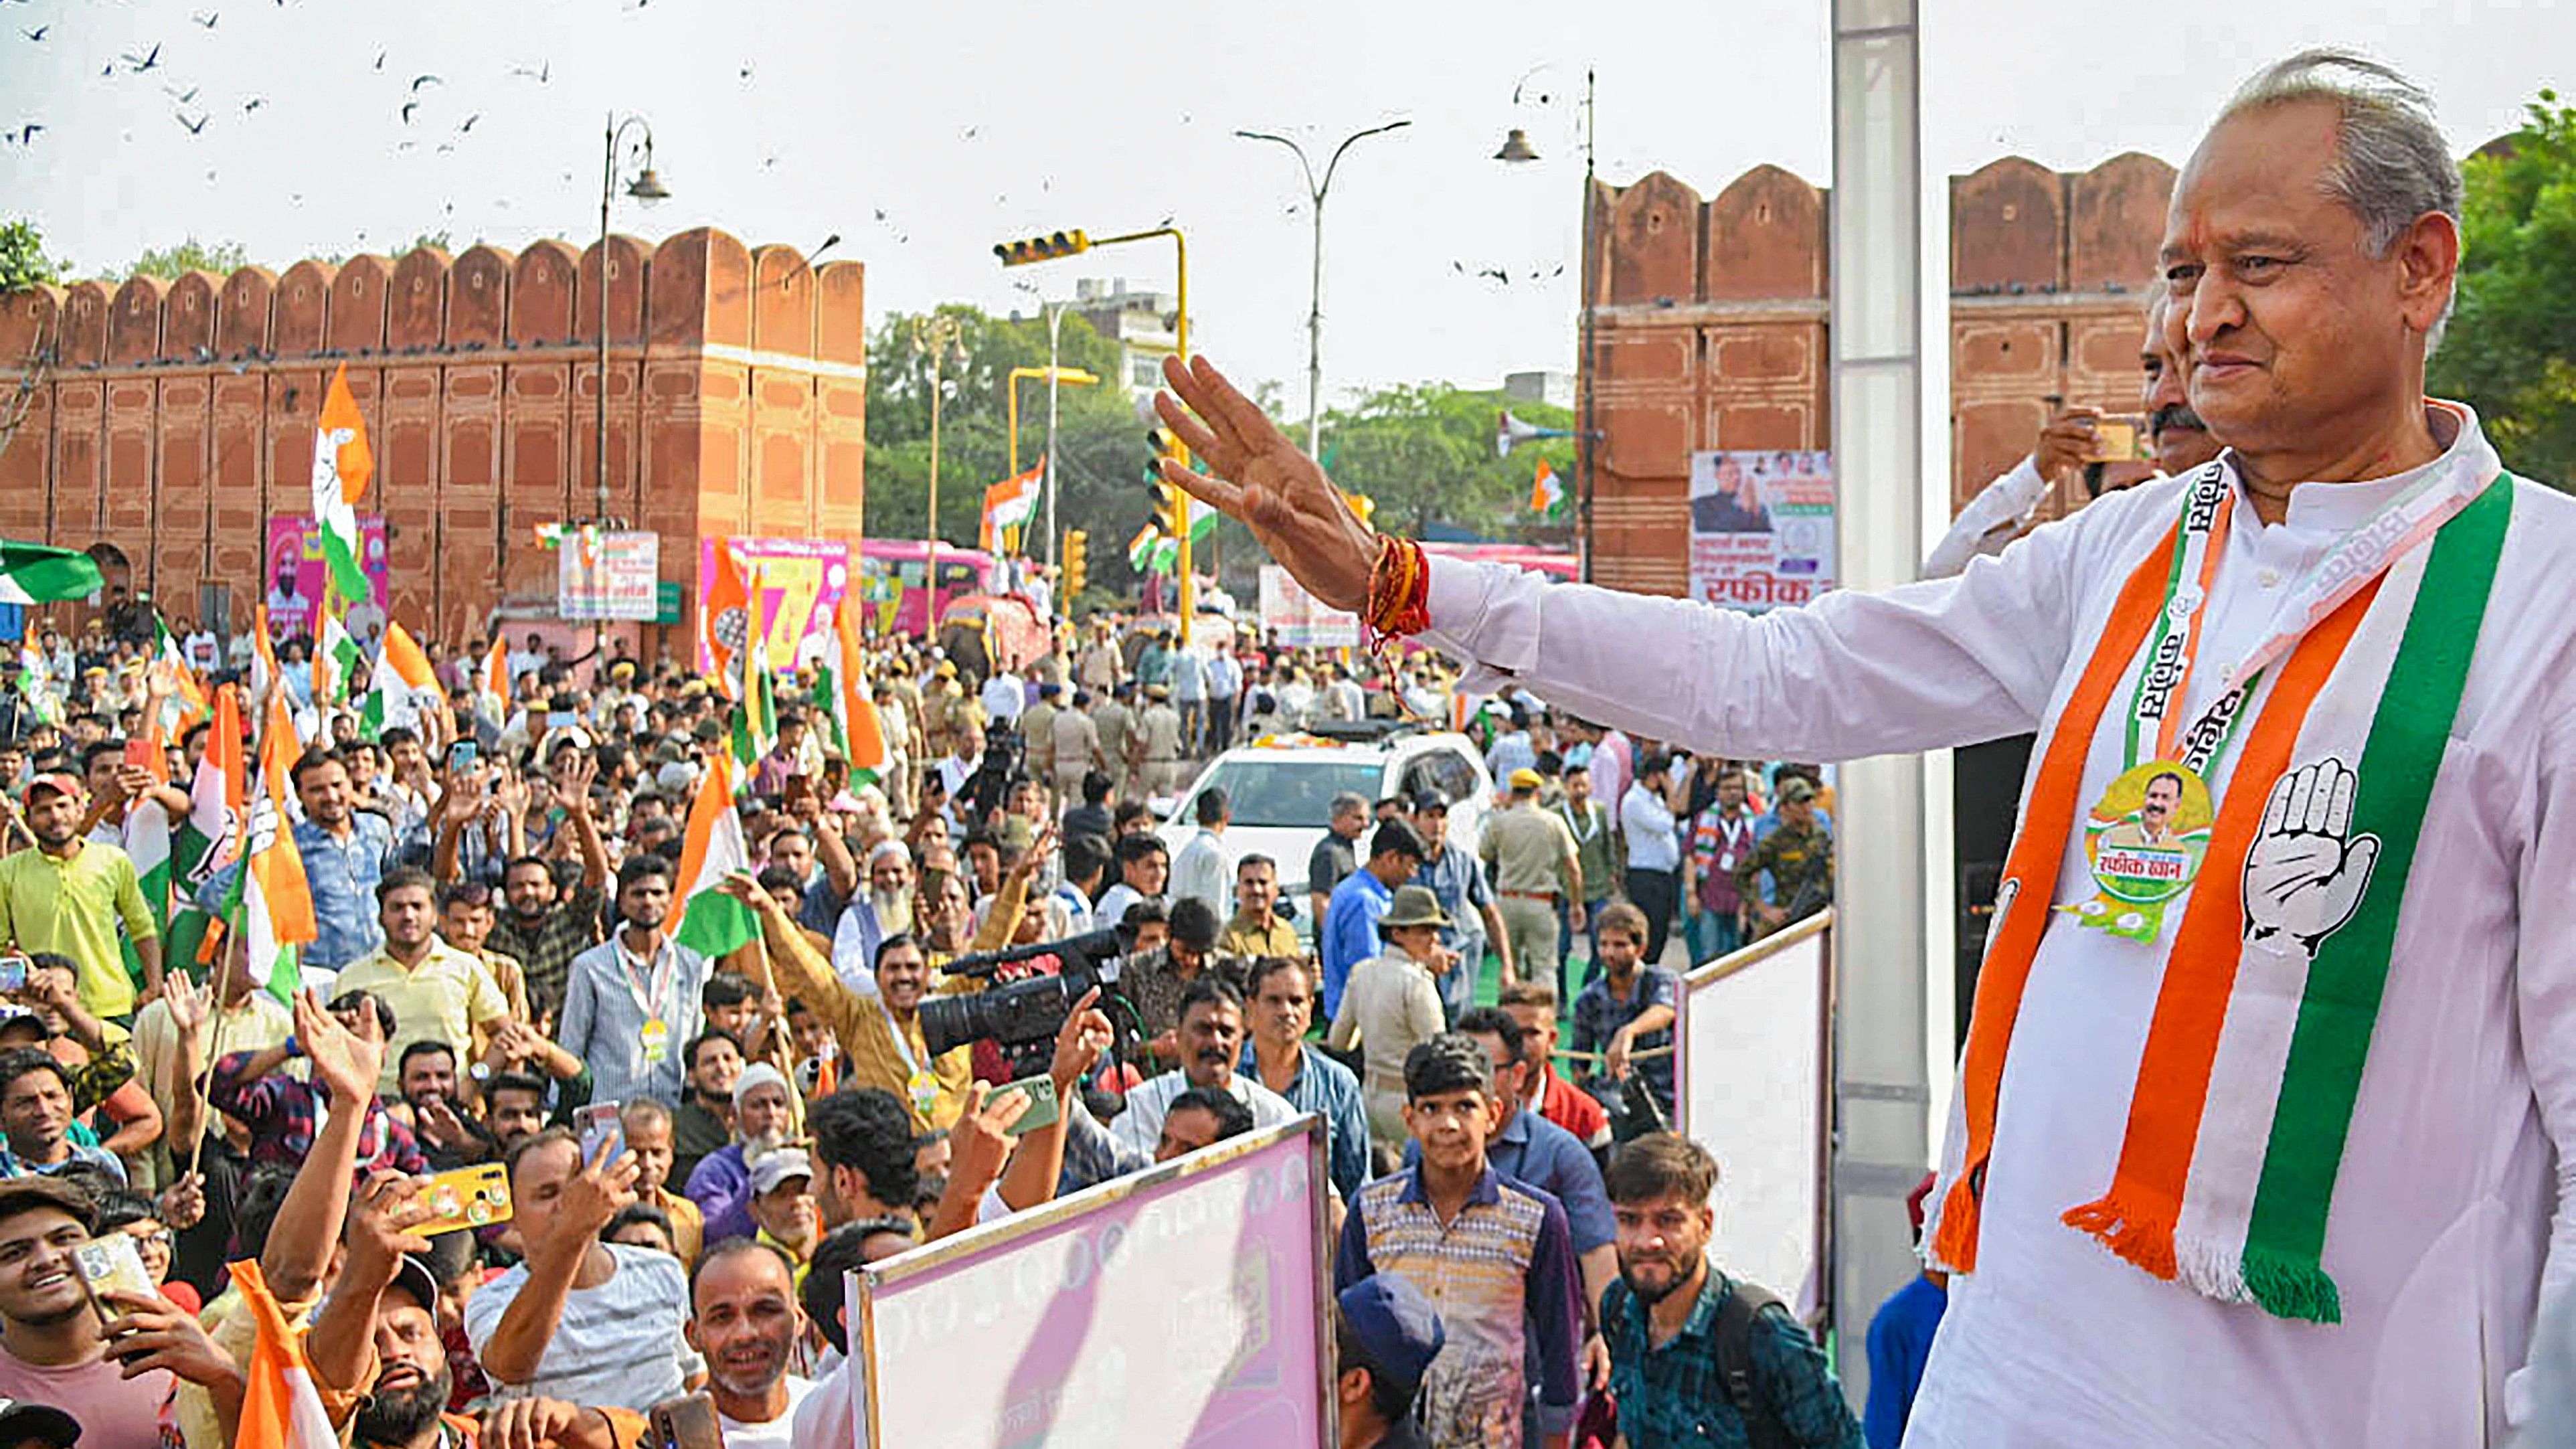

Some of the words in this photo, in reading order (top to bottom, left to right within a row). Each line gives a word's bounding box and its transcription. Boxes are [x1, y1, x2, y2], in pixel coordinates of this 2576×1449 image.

[1702, 571, 1813, 603] रफीक
[2141, 633, 2184, 720] कांग्रेस
[2100, 852, 2144, 875] रफीक
[2148, 859, 2181, 879] खान
